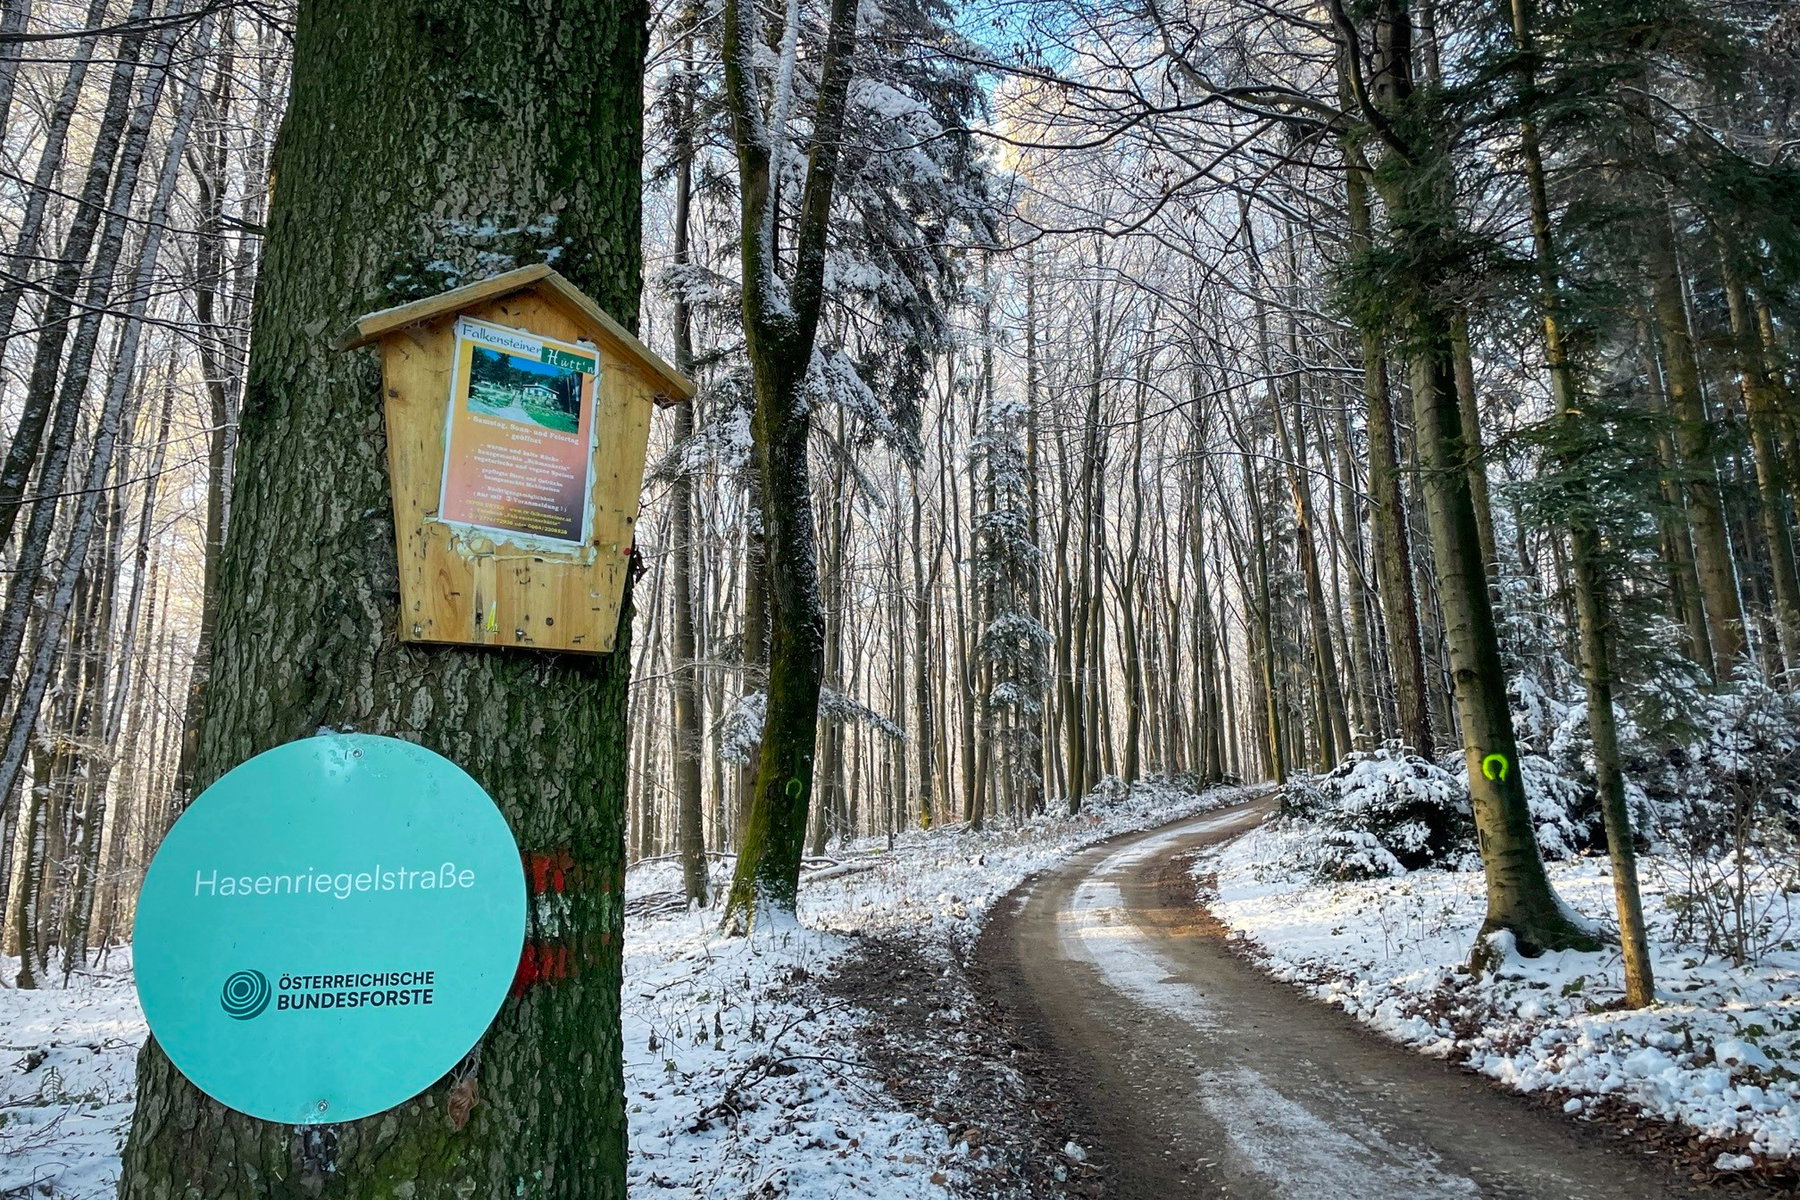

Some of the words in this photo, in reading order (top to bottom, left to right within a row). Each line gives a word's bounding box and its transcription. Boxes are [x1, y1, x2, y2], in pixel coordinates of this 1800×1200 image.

[462, 323, 542, 354] Falkensteiner
[511, 432, 541, 445] geöffnet
[533, 428, 547, 437] und
[549, 432, 579, 445] Feiertag
[194, 862, 475, 900] Hasenriegelstraße
[278, 971, 435, 990] ÖSTERREICHISCHE
[277, 989, 433, 1011] BUNDESFORSTE
